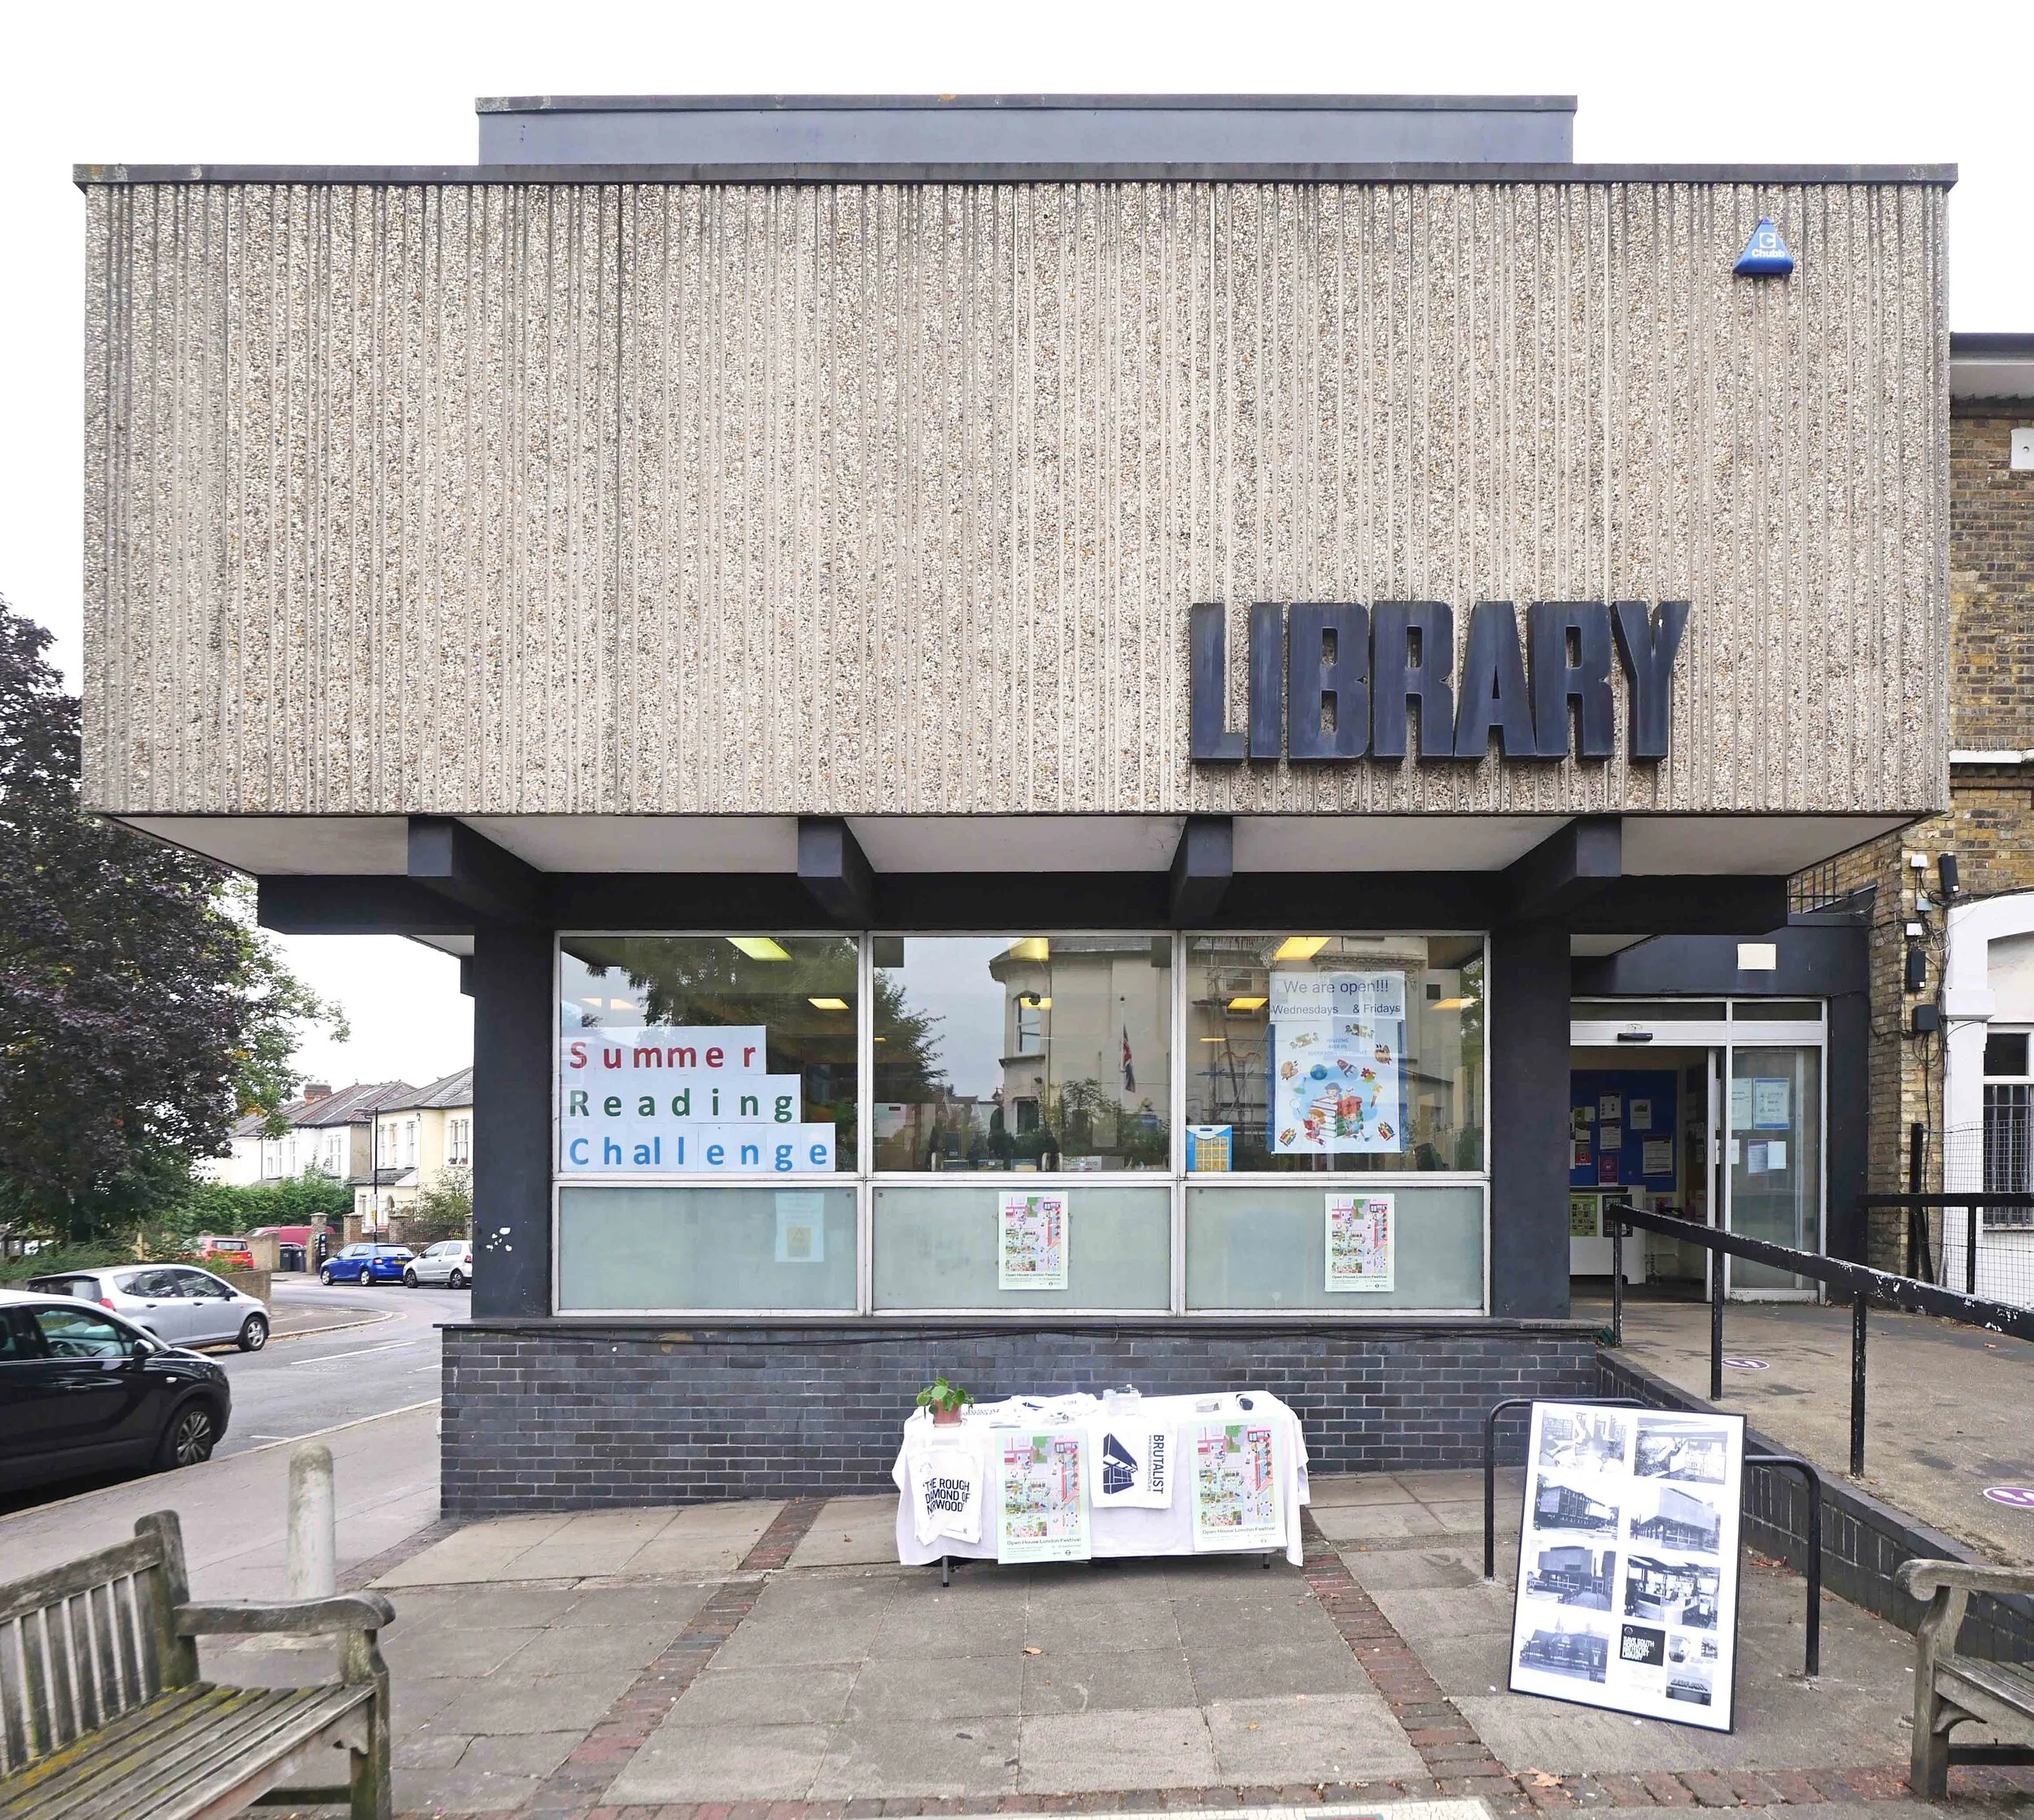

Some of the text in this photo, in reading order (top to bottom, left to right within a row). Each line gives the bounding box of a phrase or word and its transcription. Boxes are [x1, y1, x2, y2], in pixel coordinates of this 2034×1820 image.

[1752, 248, 1785, 258] Chubb
[1190, 600, 1691, 763] LIBRARY
[1284, 980, 1389, 996] We are open!!!
[1272, 1003, 1401, 1016] Wednesdays & Fridays
[570, 1041, 757, 1069] Summer
[570, 1088, 793, 1124] Reading
[570, 1137, 827, 1172] Challenge
[1153, 1434, 1164, 1495] BRUTALIST
[939, 1477, 970, 1492] ROUGH
[962, 1491, 971, 1504] OF
